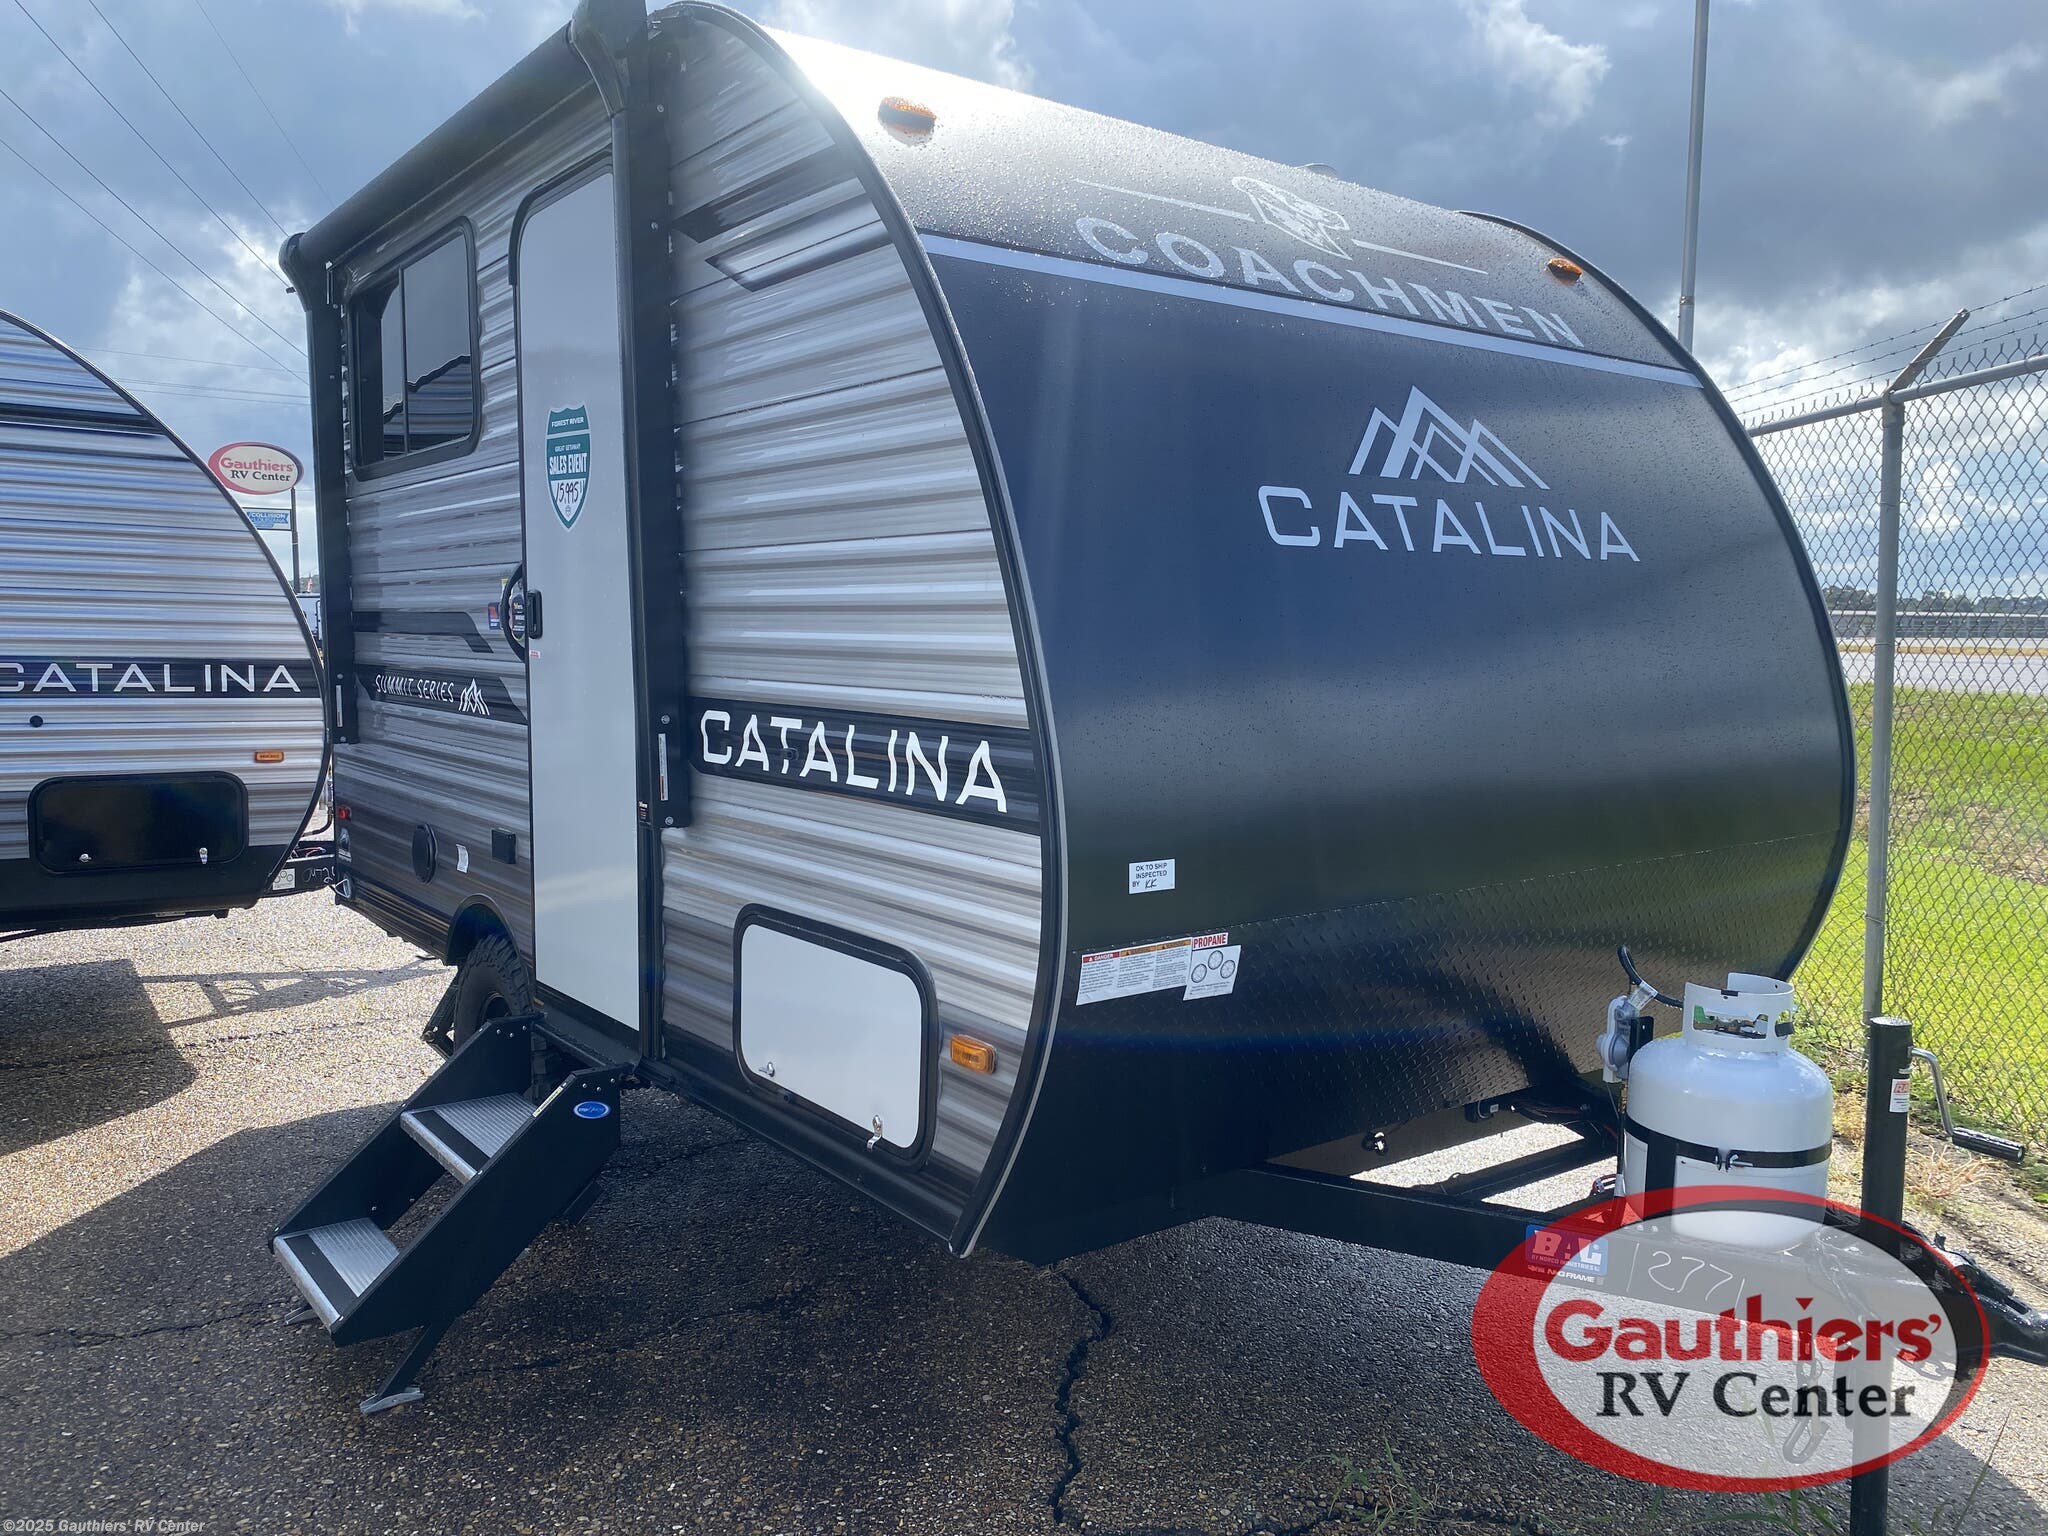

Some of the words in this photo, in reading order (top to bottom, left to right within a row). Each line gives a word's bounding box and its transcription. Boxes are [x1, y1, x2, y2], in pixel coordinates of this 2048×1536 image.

[1076, 216, 1585, 349] COACHMEN
[551, 419, 569, 428] FOREST
[570, 417, 584, 425] RIVER
[549, 456, 567, 475] SALES
[568, 453, 587, 474] EVENT
[230, 470, 248, 479] RV
[252, 471, 291, 482] Center
[1258, 485, 1640, 563] CATALINA
[0, 662, 302, 693] CATALINA
[375, 674, 414, 696] SUMMIT
[416, 678, 455, 703] SERIES
[700, 709, 1008, 813] CATALINA
[1135, 870, 1168, 879] INSPECTED
[1145, 863, 1154, 871] TO
[1154, 862, 1168, 870] SHIP
[1193, 933, 1227, 949] PROPANE
[1566, 1272, 1596, 1283] FRAME
